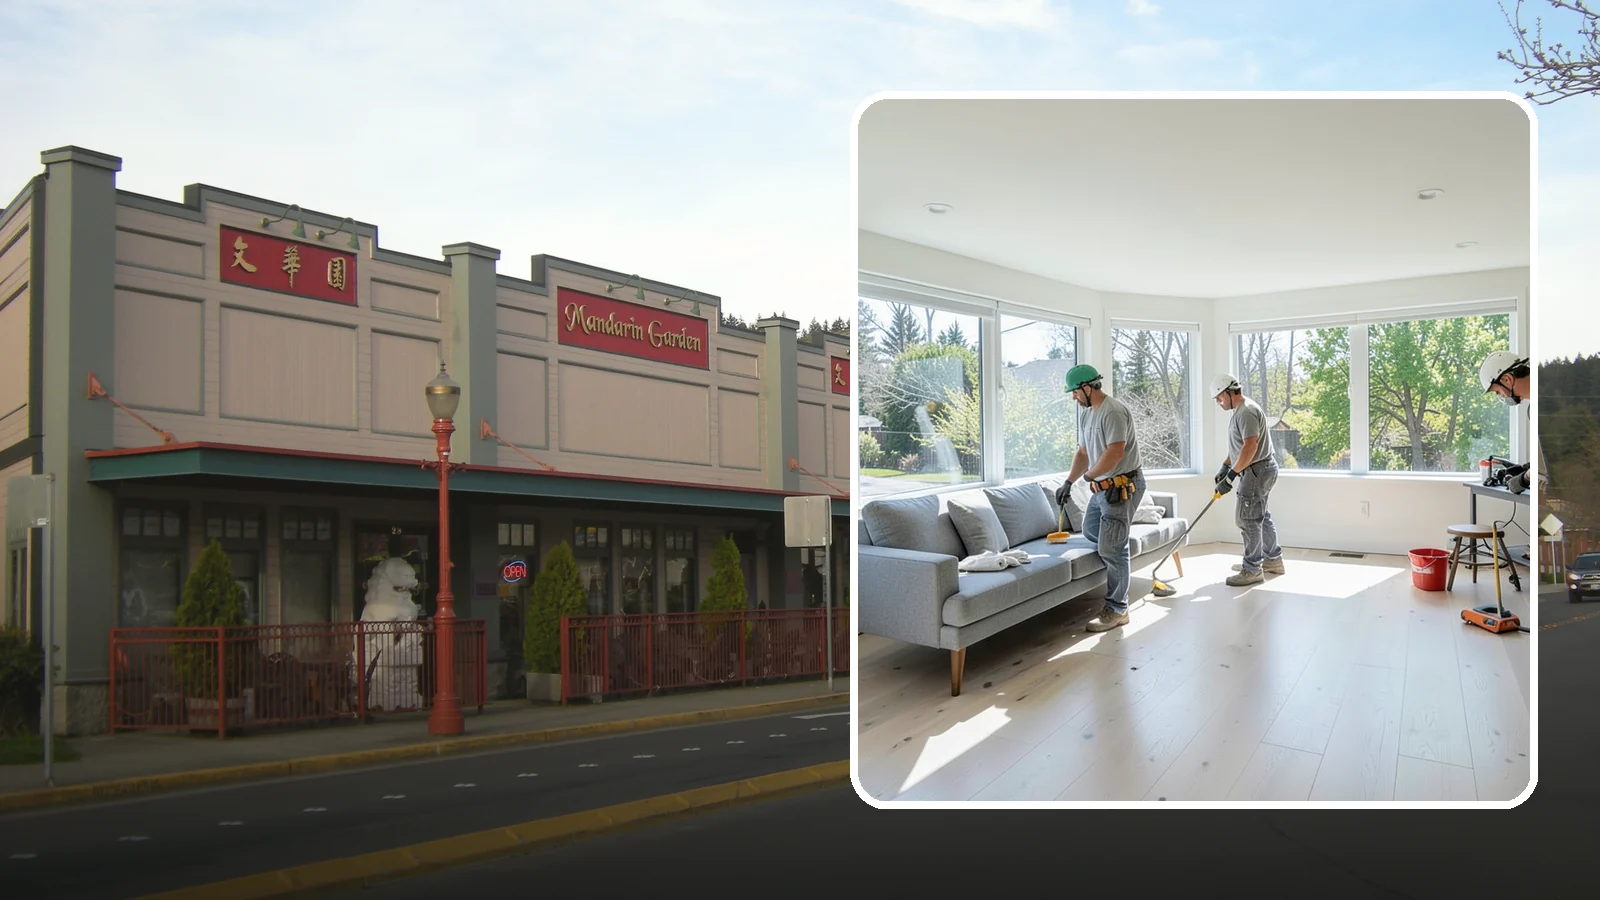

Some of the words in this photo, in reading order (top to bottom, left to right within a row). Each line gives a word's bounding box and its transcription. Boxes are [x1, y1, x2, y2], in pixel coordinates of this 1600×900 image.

[231, 235, 346, 290] 文華園
[564, 302, 644, 341] Mandarin
[648, 320, 701, 352] Garden
[503, 565, 527, 578] OPEN
